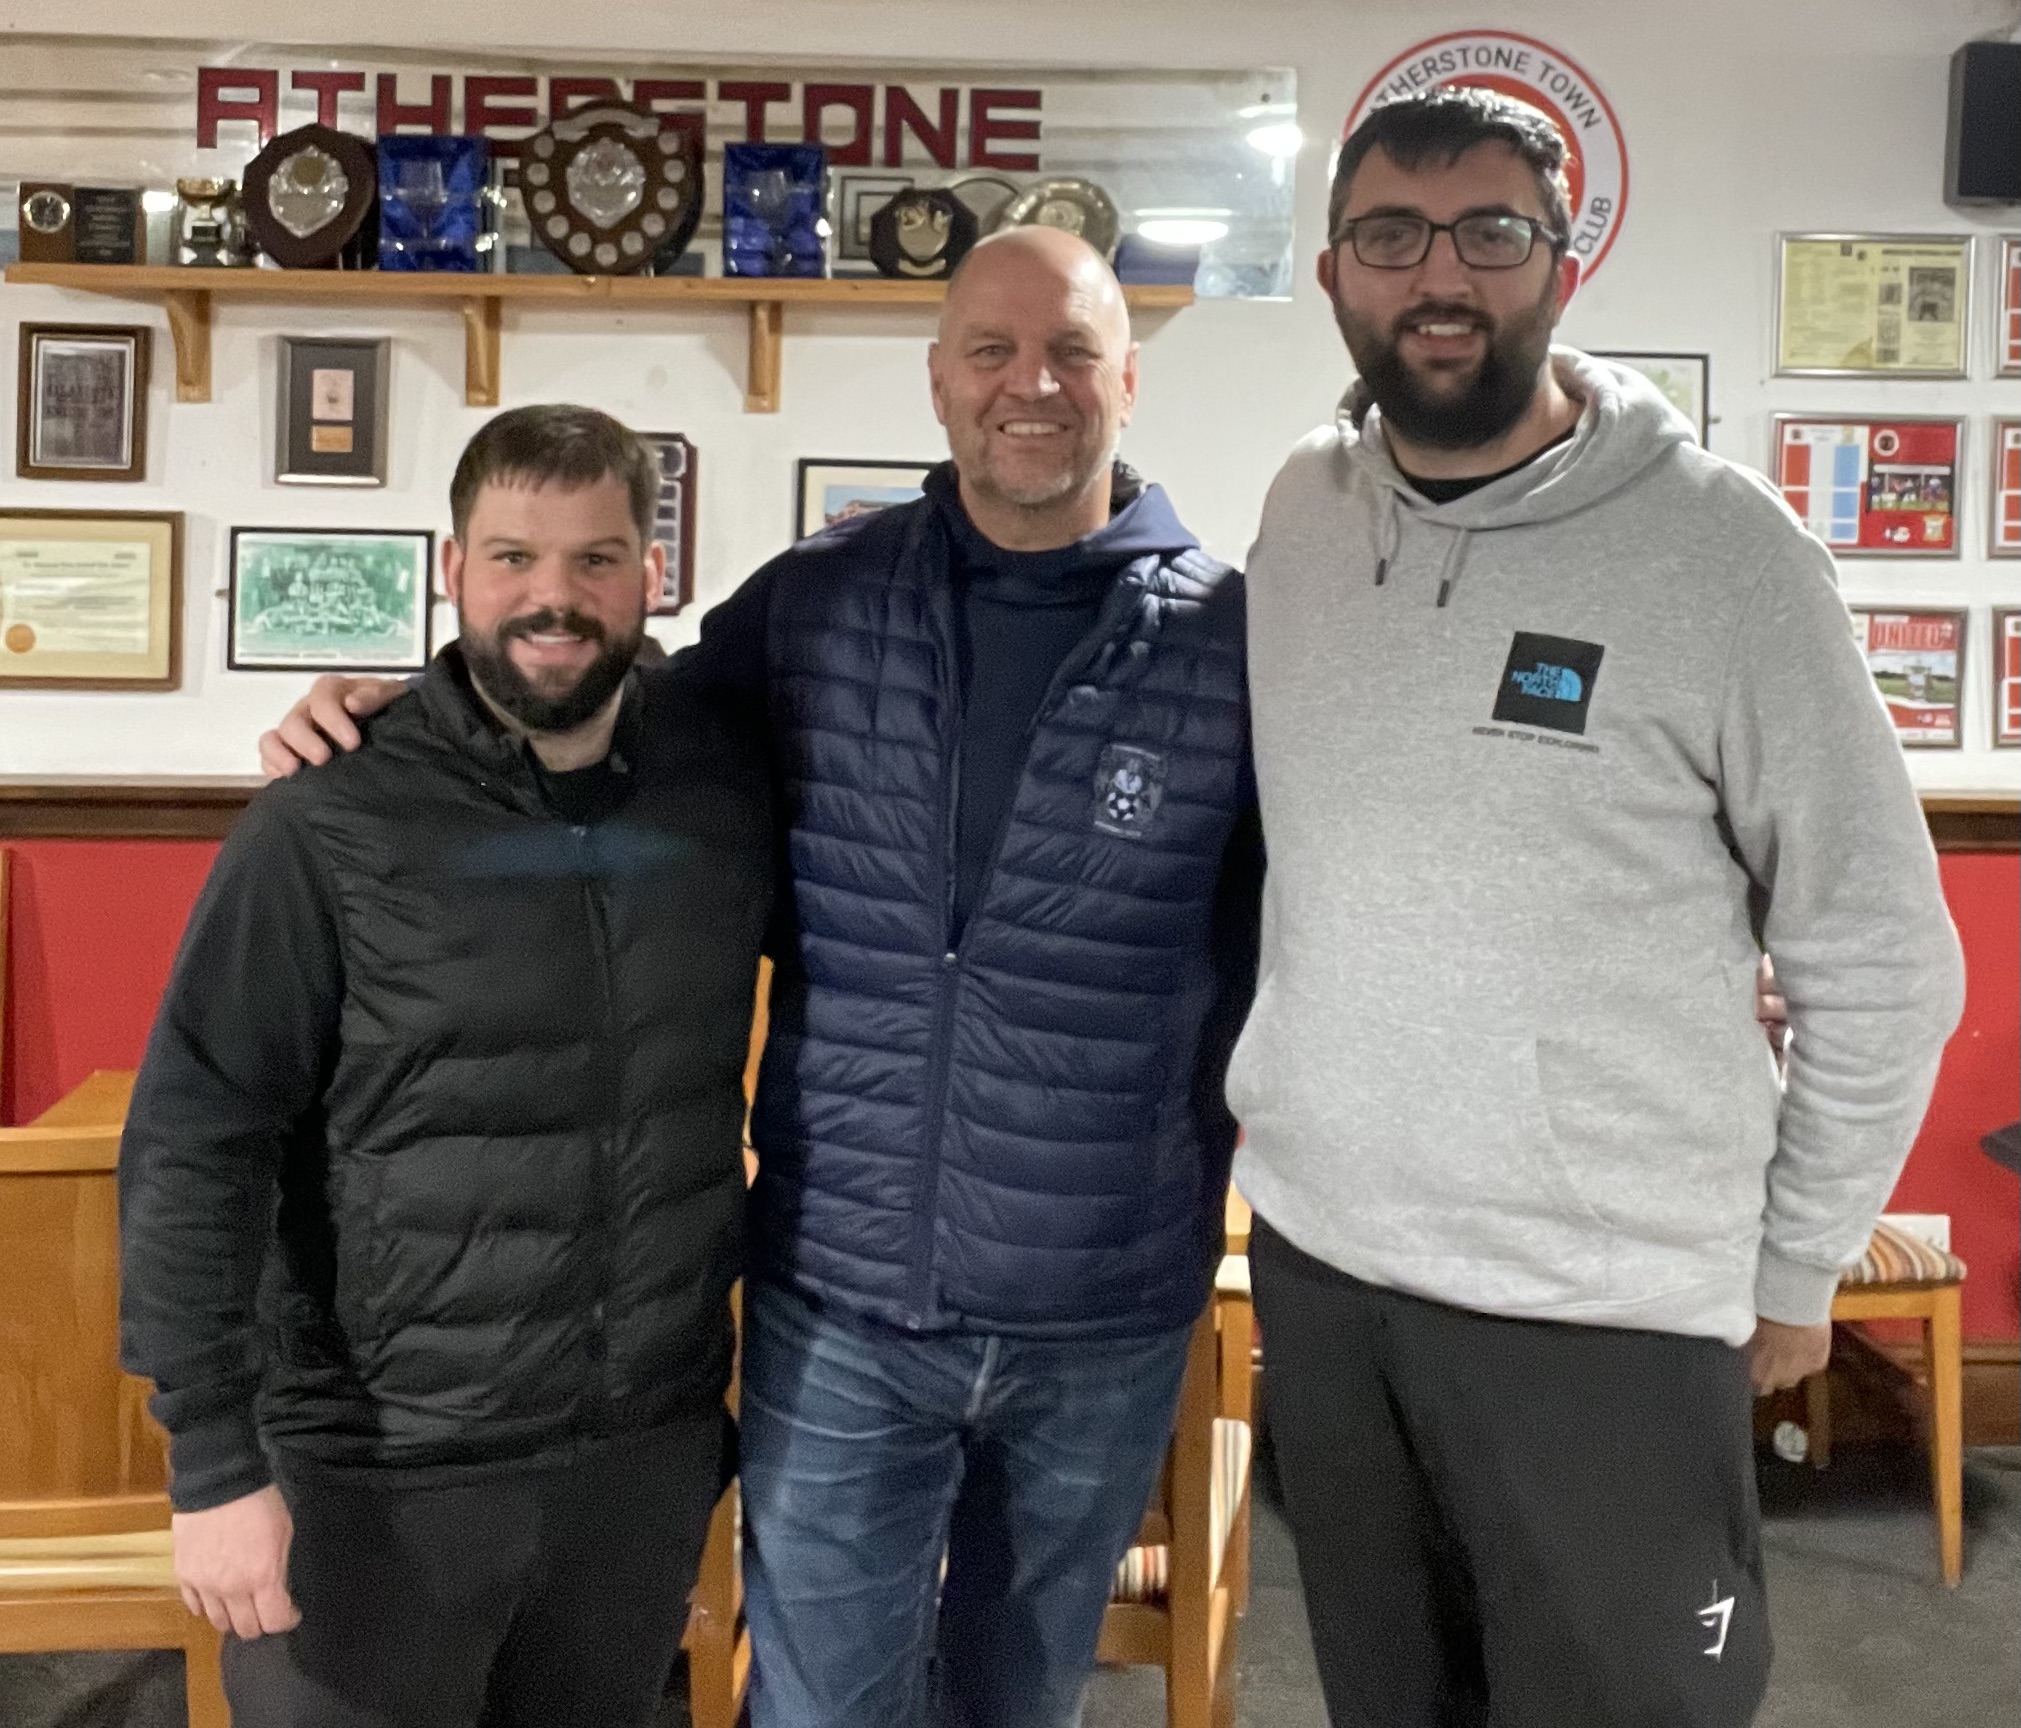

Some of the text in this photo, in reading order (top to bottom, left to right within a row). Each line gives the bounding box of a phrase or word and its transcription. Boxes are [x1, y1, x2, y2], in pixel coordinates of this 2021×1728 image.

[1374, 46, 1603, 131] THERSTONE TOWN
[1573, 196, 1613, 256] CLUB
